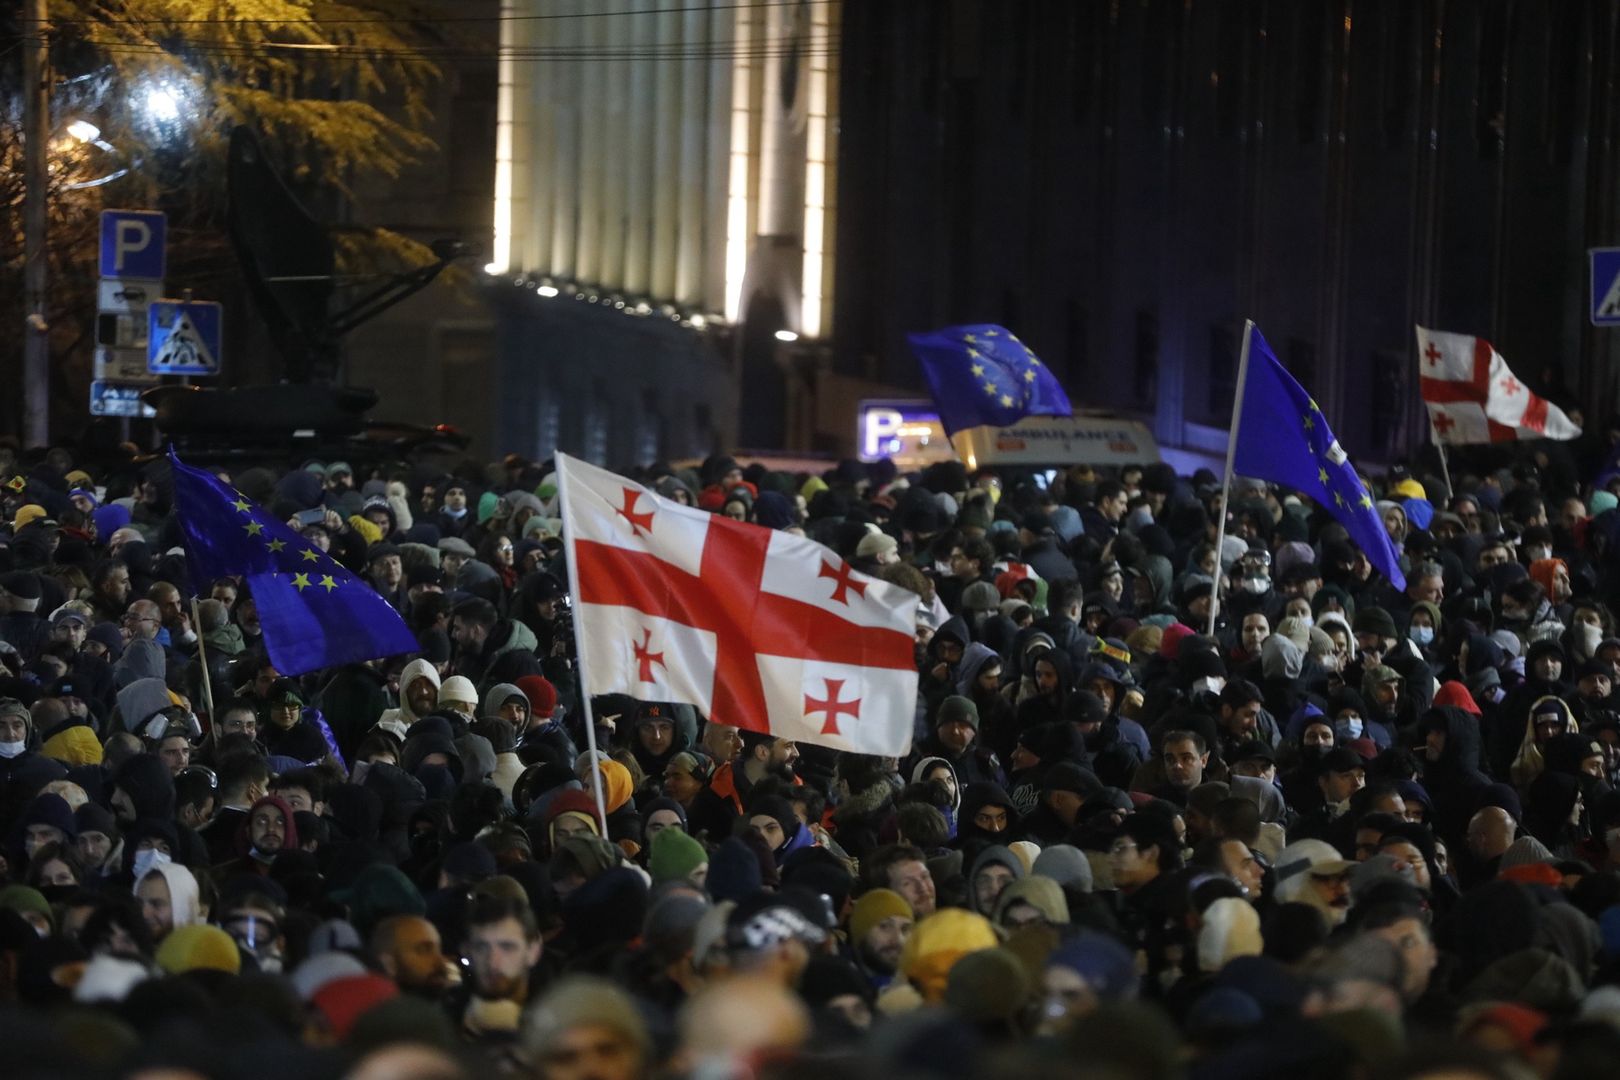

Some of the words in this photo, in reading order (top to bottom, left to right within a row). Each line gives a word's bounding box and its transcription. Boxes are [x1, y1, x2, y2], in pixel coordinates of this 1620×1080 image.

[114, 220, 151, 271] P
[865, 408, 903, 456] P
[998, 428, 1130, 441] AMBULANCE
